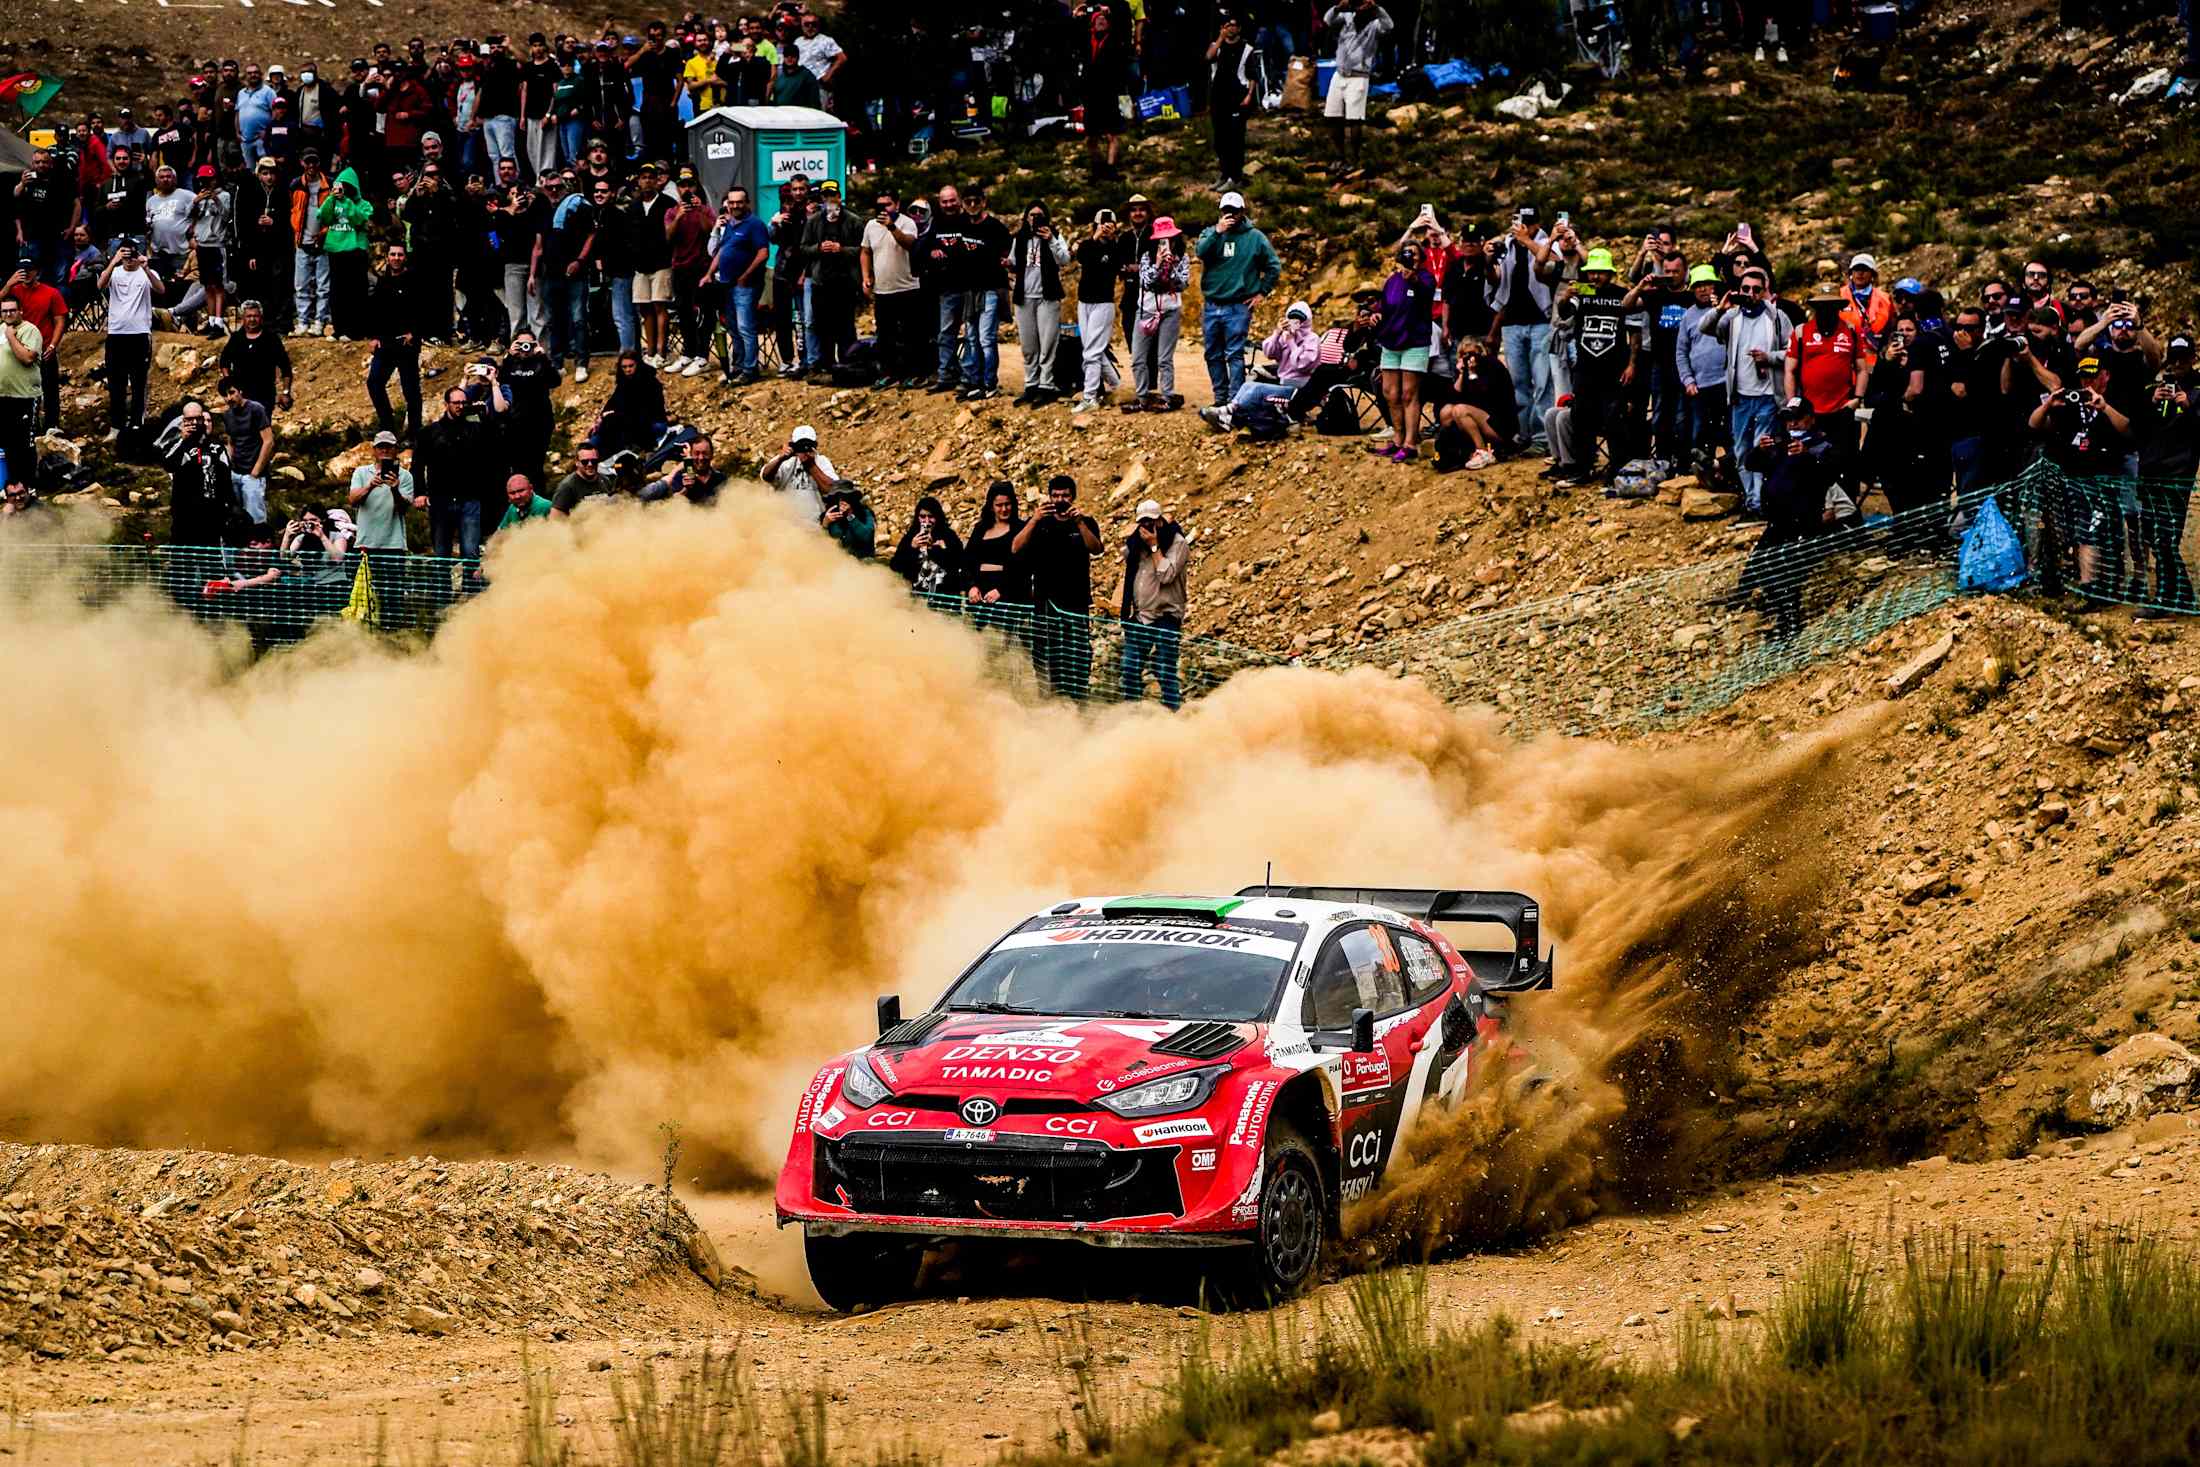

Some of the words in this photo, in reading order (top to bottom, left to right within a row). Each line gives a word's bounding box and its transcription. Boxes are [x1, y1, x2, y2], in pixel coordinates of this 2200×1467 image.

[941, 1046, 1082, 1063] DENSO
[942, 1066, 1053, 1082] TAMADIC
[1118, 1060, 1189, 1083] codebeamer
[1356, 1060, 1388, 1075] Portugal
[1229, 1080, 1264, 1145] Panasonic
[1246, 1080, 1278, 1150] AUTOMOTIVE
[1192, 1153, 1216, 1167] OMP
